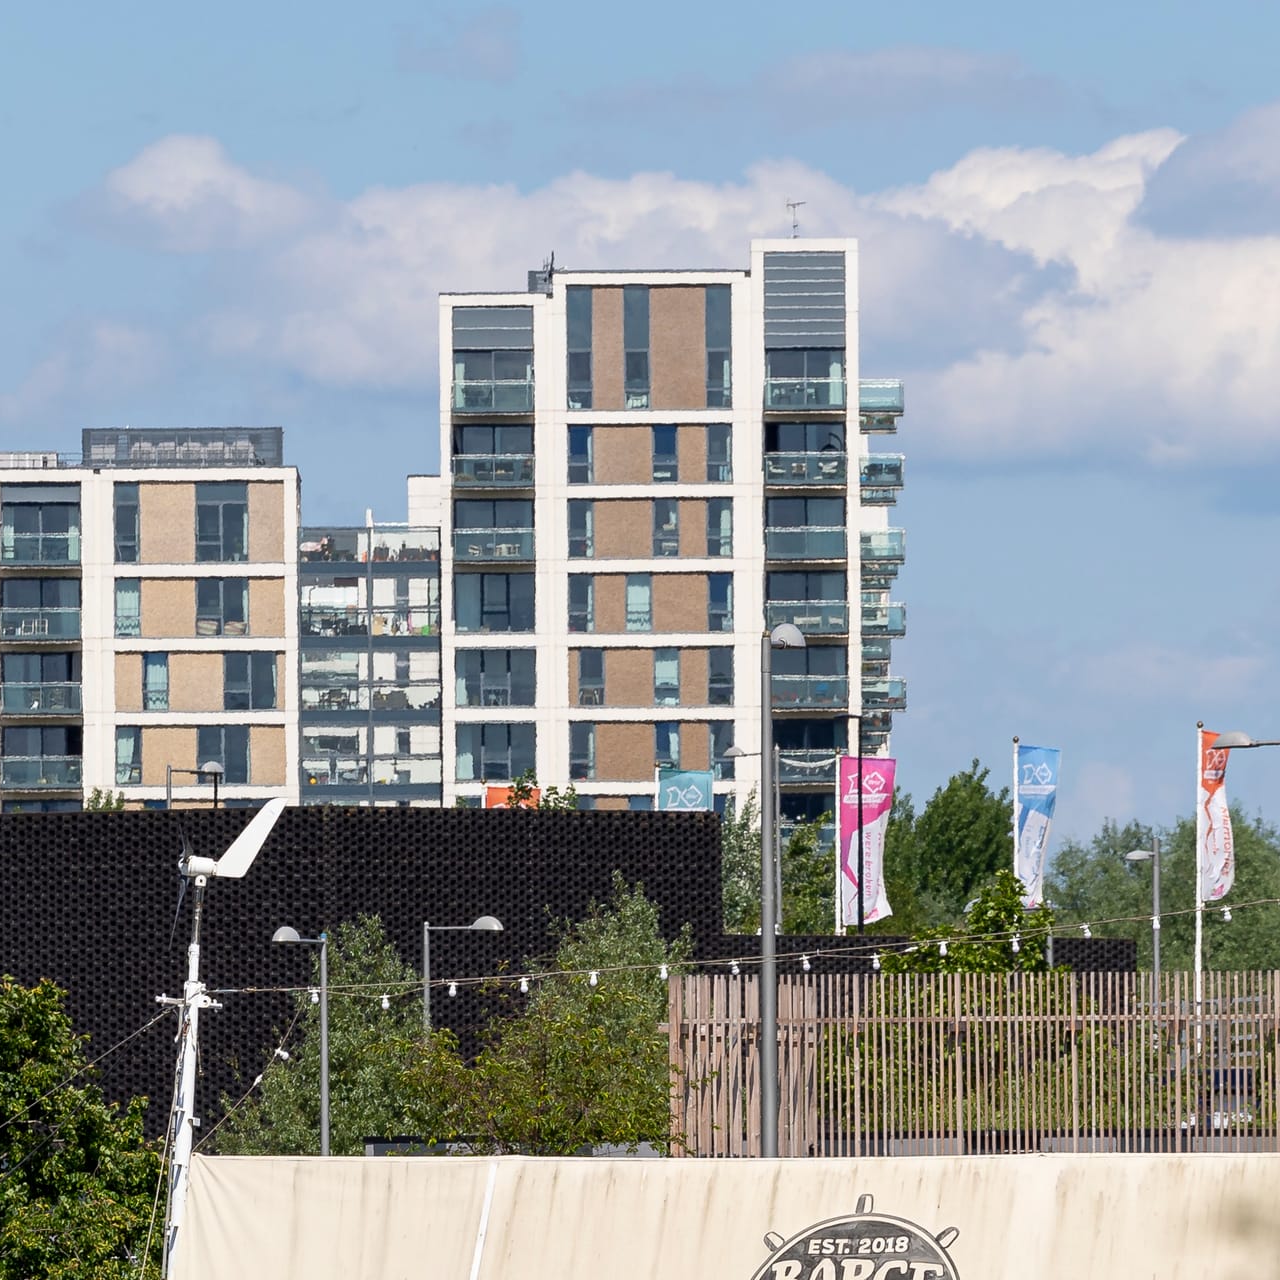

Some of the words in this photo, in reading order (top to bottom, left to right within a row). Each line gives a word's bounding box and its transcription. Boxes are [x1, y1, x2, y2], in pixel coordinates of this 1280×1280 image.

[865, 860, 873, 896] broken
[808, 1238, 850, 1254] EST.
[858, 1236, 910, 1254] 2018
